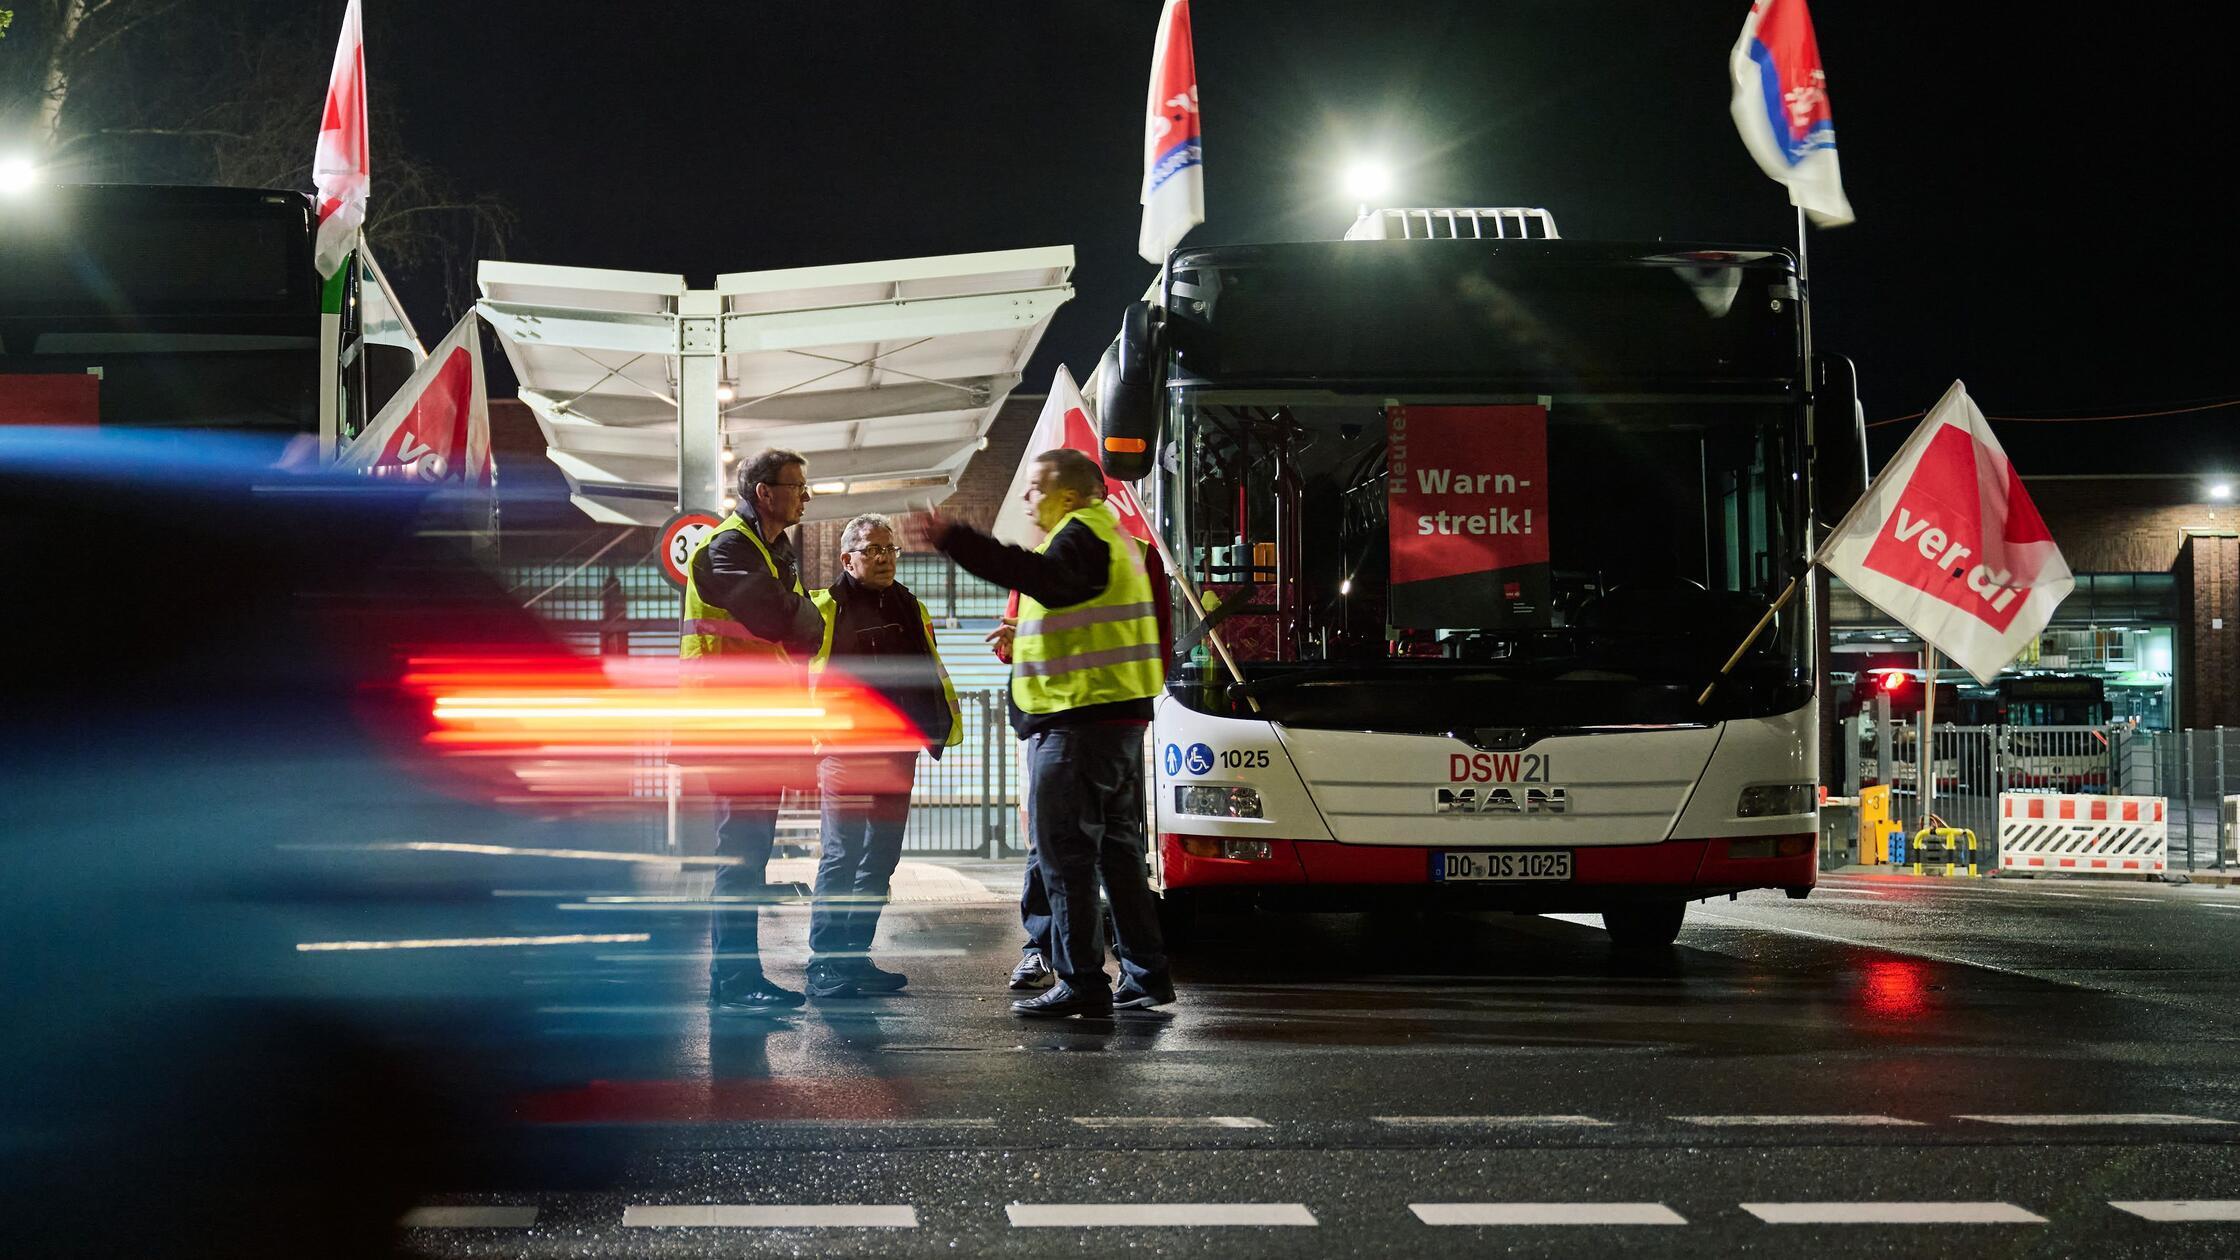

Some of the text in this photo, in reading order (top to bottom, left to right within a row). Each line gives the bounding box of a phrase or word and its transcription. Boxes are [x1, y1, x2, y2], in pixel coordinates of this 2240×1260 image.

[1389, 409, 1408, 494] Heute:
[1416, 468, 1531, 495] Warn-
[1417, 507, 1533, 535] streik!
[1894, 507, 2023, 613] ver.di
[1220, 749, 1270, 769] 1025
[1450, 753, 1550, 783] DSW21
[1435, 787, 1566, 814] MAN
[1446, 855, 1472, 877] DO
[1488, 855, 1513, 877] DS
[1518, 854, 1568, 877] 1025
